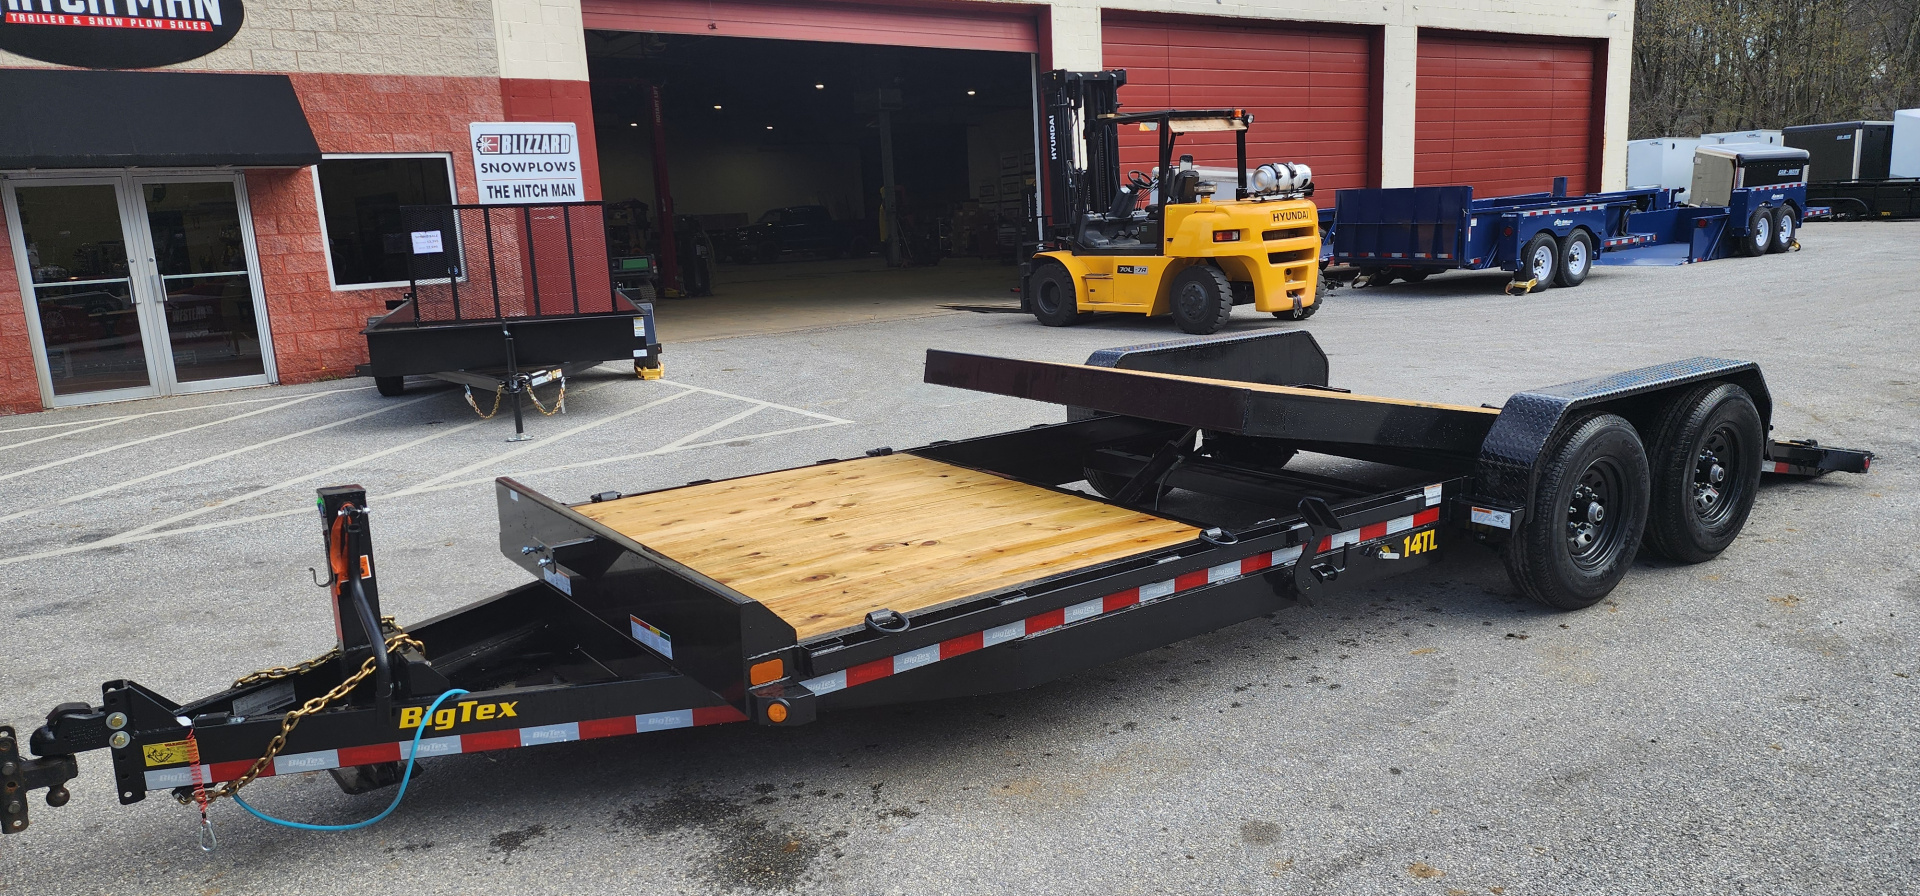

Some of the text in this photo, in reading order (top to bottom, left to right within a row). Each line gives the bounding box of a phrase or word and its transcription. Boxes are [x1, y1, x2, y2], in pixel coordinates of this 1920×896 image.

[11, 13, 207, 30] TRAILER & SNOW PLOW SALES
[501, 134, 570, 154] BLIZZARD
[1049, 115, 1057, 160] HYUNDAI
[481, 161, 576, 173] SNOWPLOWS
[486, 183, 576, 199] THE HITCH MAN
[1272, 210, 1309, 222] HYUNDAI
[1403, 529, 1438, 558] 14TL
